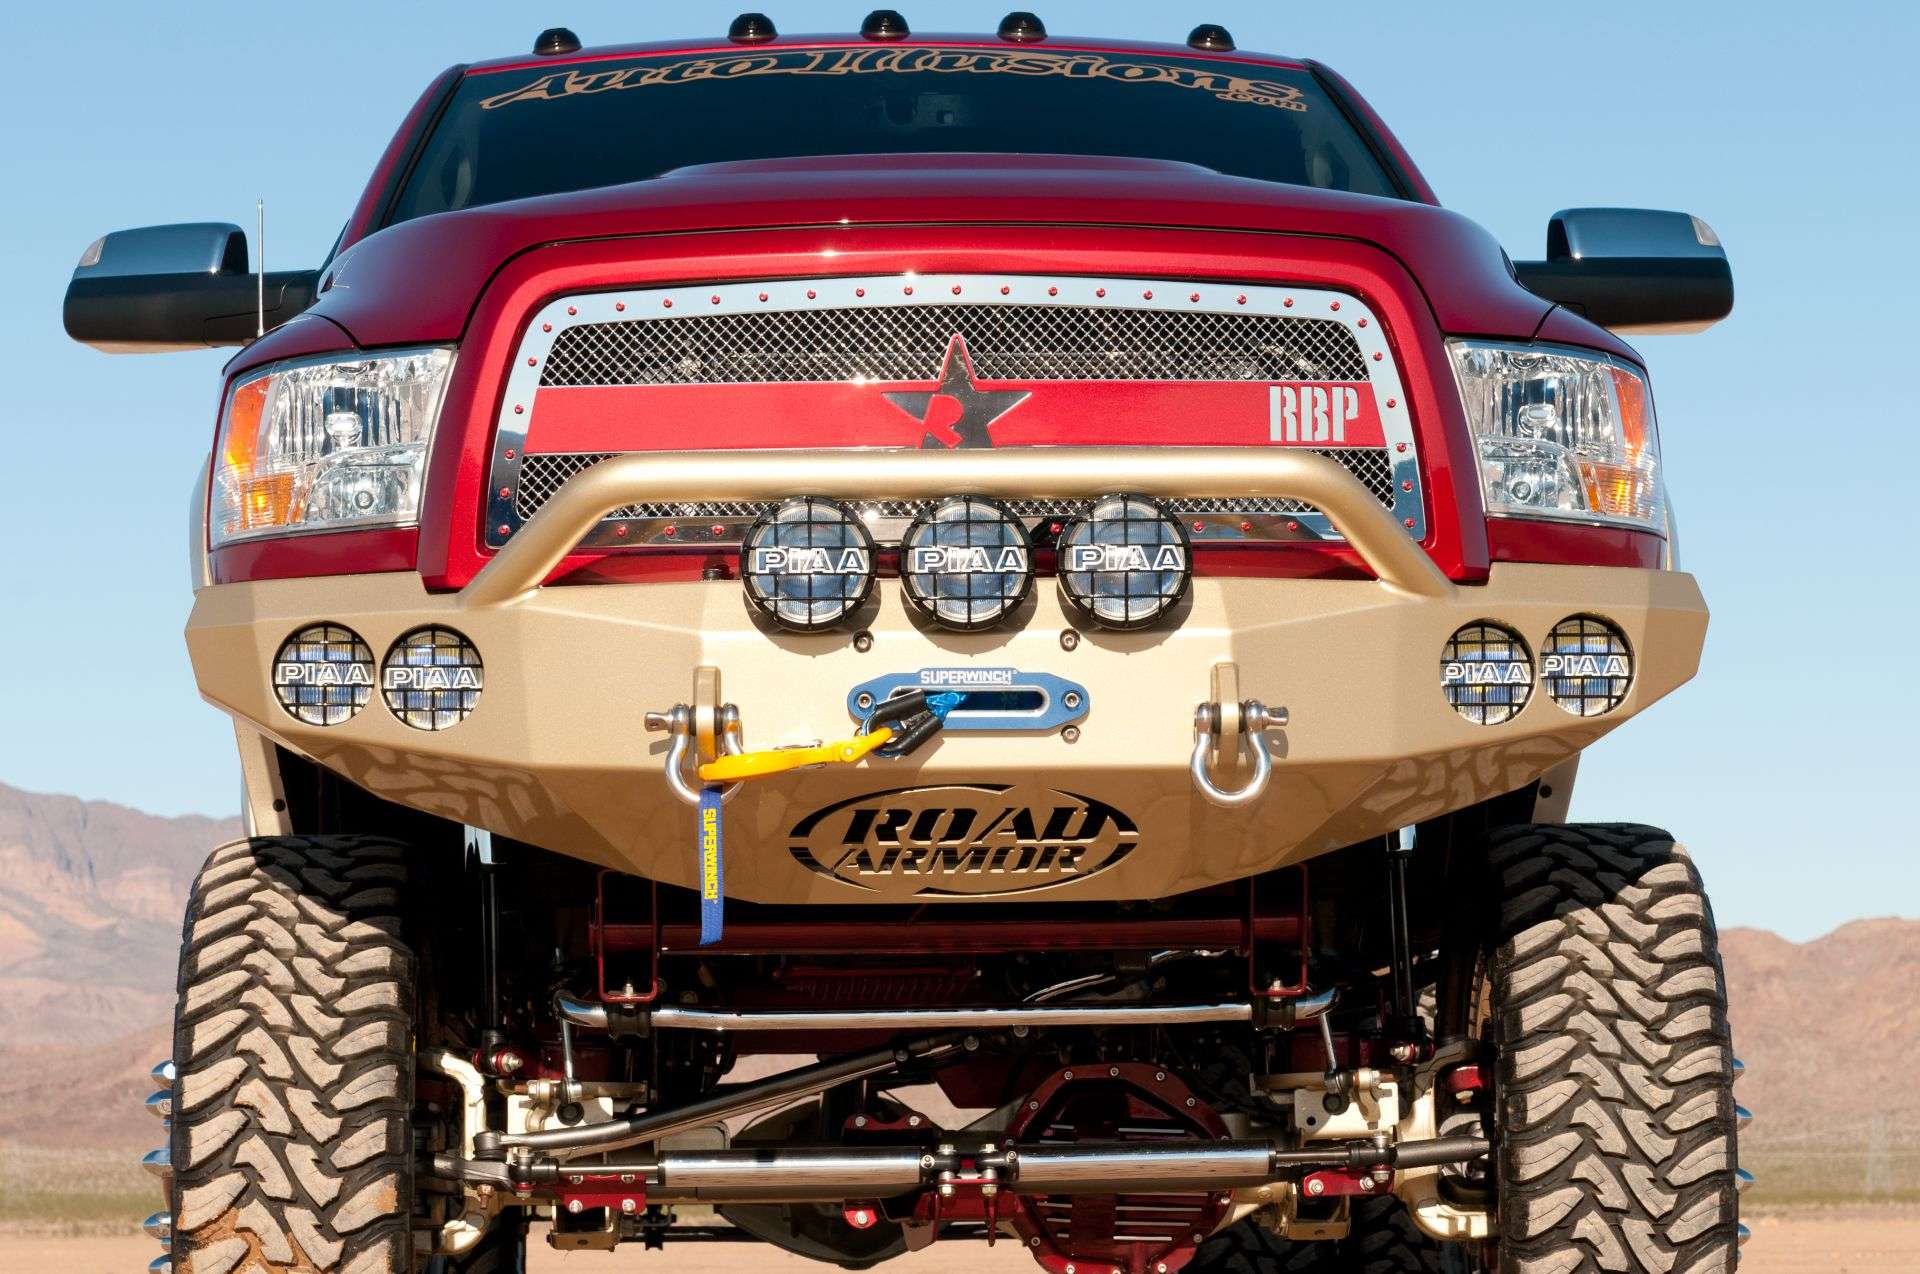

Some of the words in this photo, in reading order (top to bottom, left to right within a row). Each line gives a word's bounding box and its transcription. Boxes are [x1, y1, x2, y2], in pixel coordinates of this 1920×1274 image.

[1269, 386, 1359, 442] RBP
[755, 547, 870, 574] PIAA
[914, 546, 1027, 574] PIAA
[1072, 545, 1185, 572] PIAA
[276, 662, 374, 685] PIAA
[385, 667, 478, 689] PIAA
[920, 669, 1012, 685] SUPERWINCH
[1440, 662, 1531, 686] PIAA
[1540, 654, 1629, 677] PIAA
[842, 806, 1109, 846] ROAD
[703, 808, 719, 900] SUPERWINCH
[832, 845, 1088, 875] ARMOR
